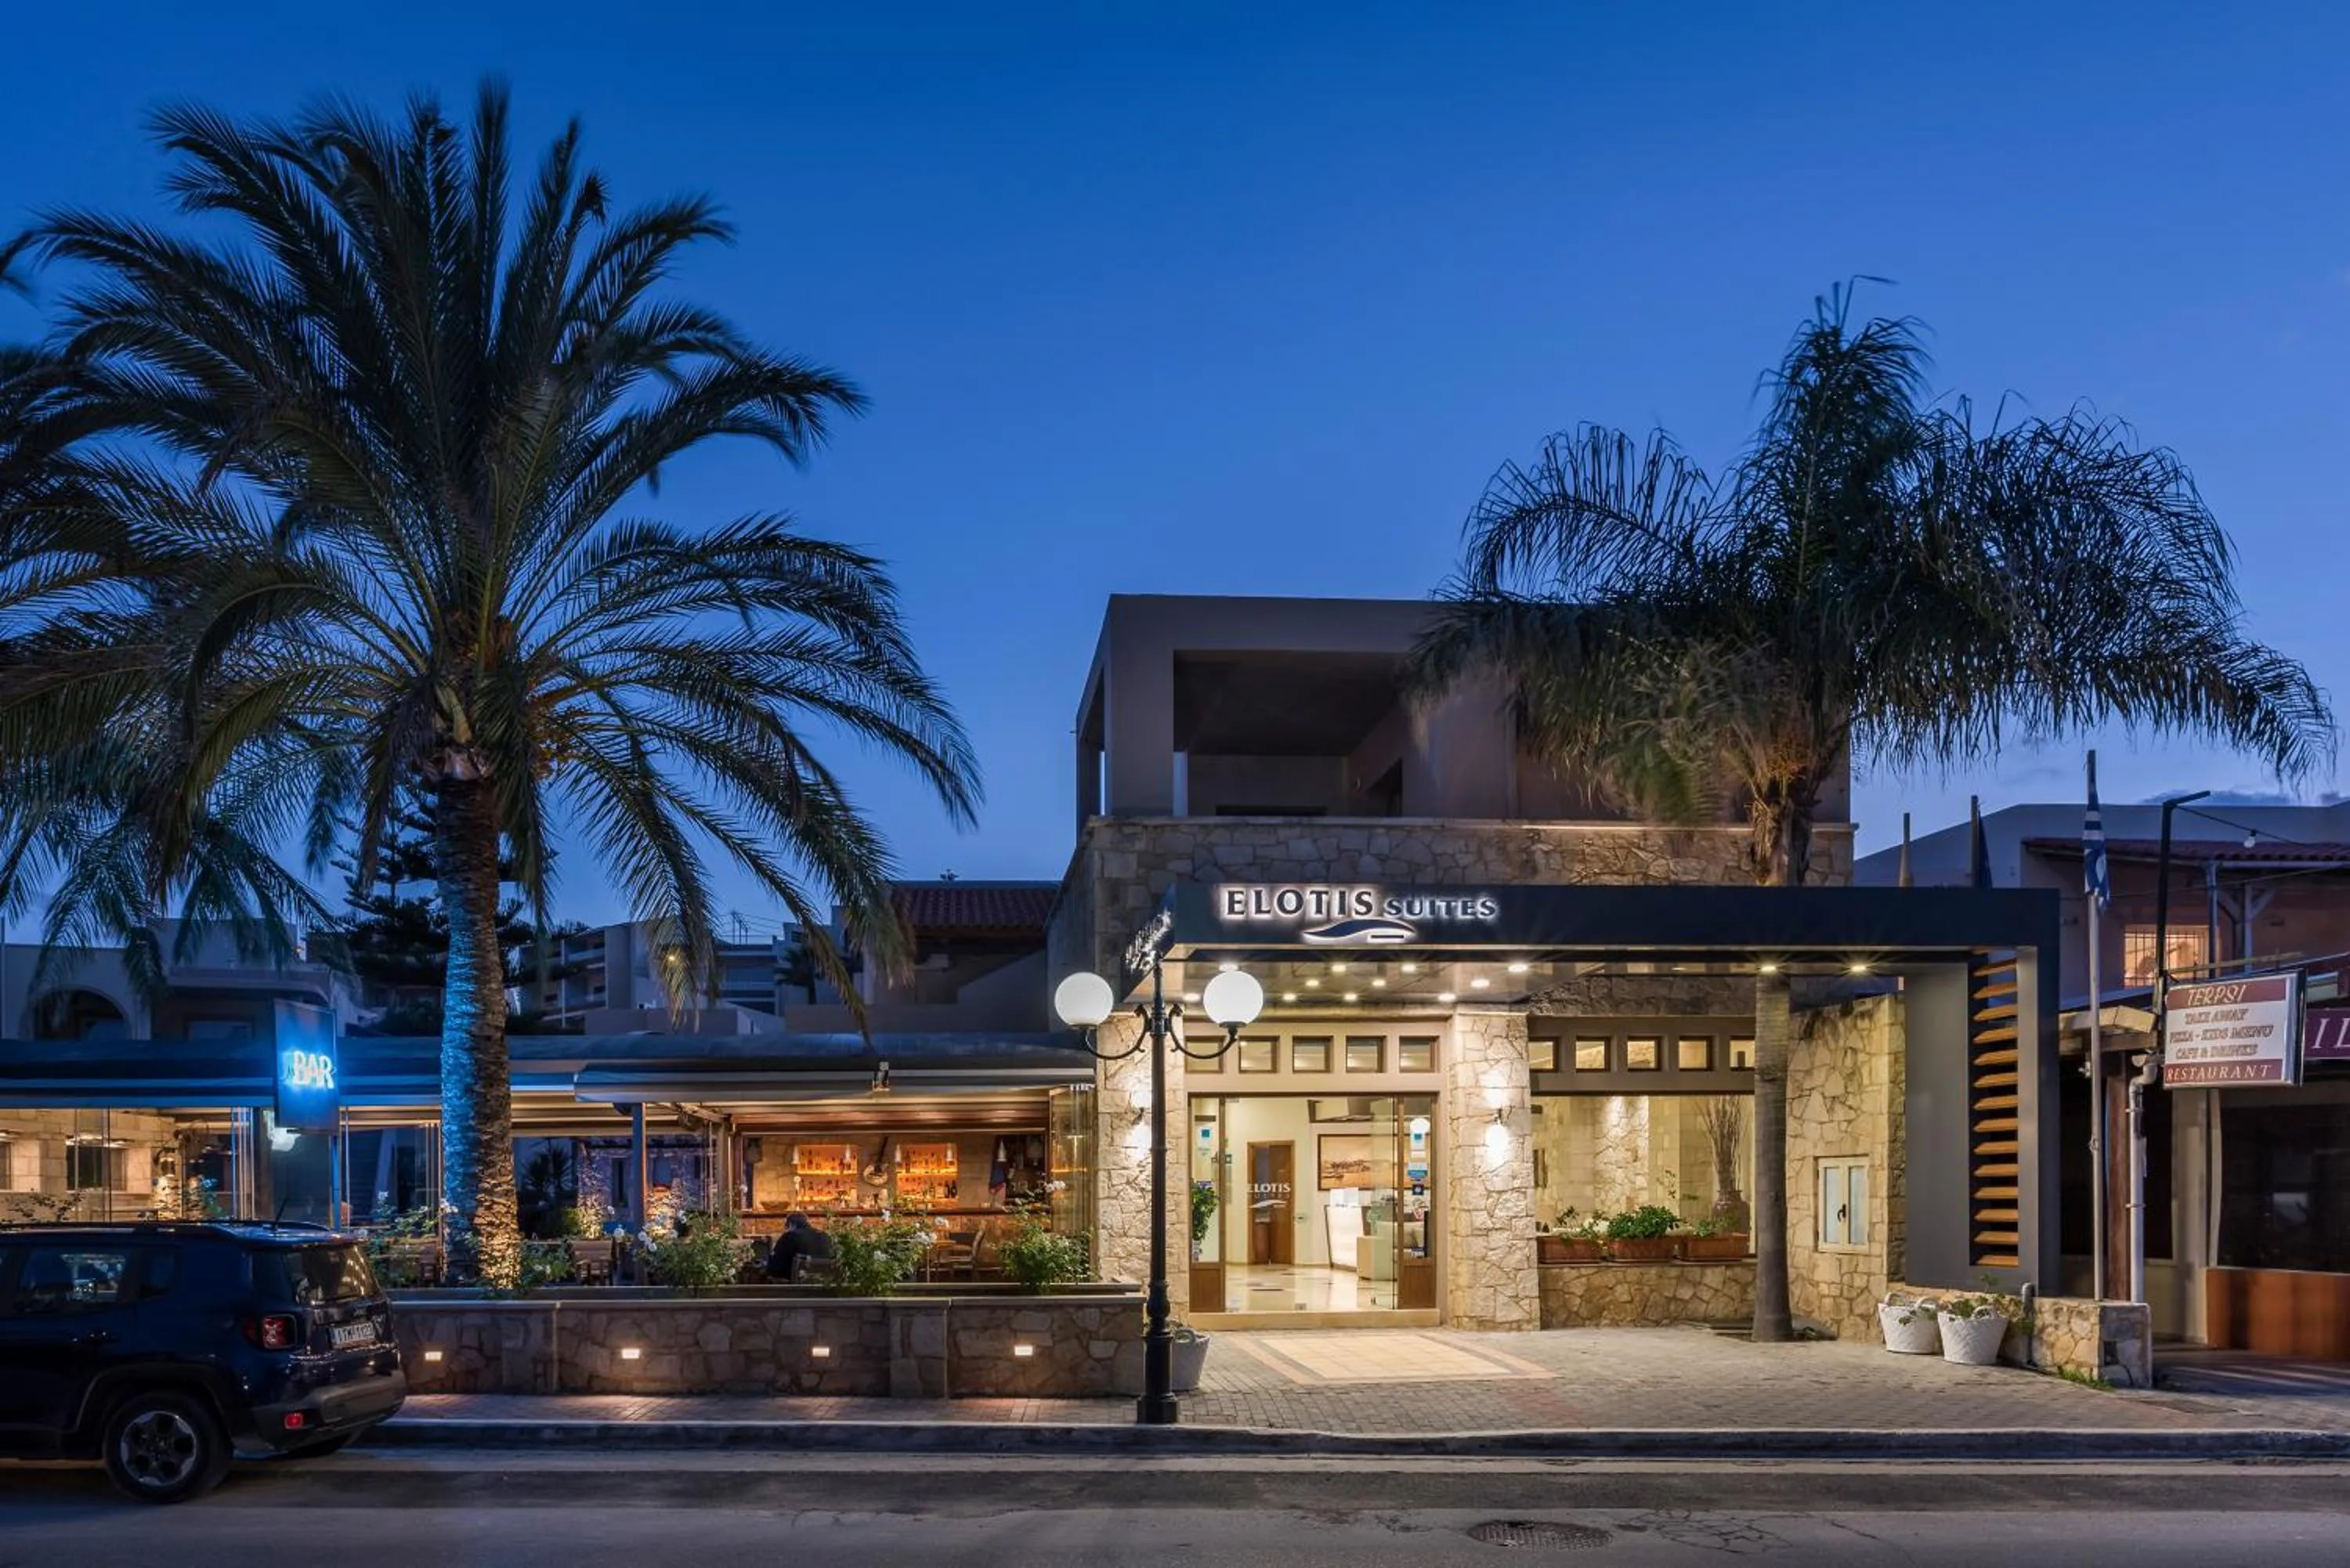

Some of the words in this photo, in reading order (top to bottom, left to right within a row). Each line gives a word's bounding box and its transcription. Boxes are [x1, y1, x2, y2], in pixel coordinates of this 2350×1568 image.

[1226, 888, 1374, 917] ELOTIS
[1383, 897, 1497, 918] SUITES
[2187, 985, 2247, 1006] TERPSI
[293, 1050, 334, 1089] BAR
[2166, 1064, 2271, 1082] RESTAURANT
